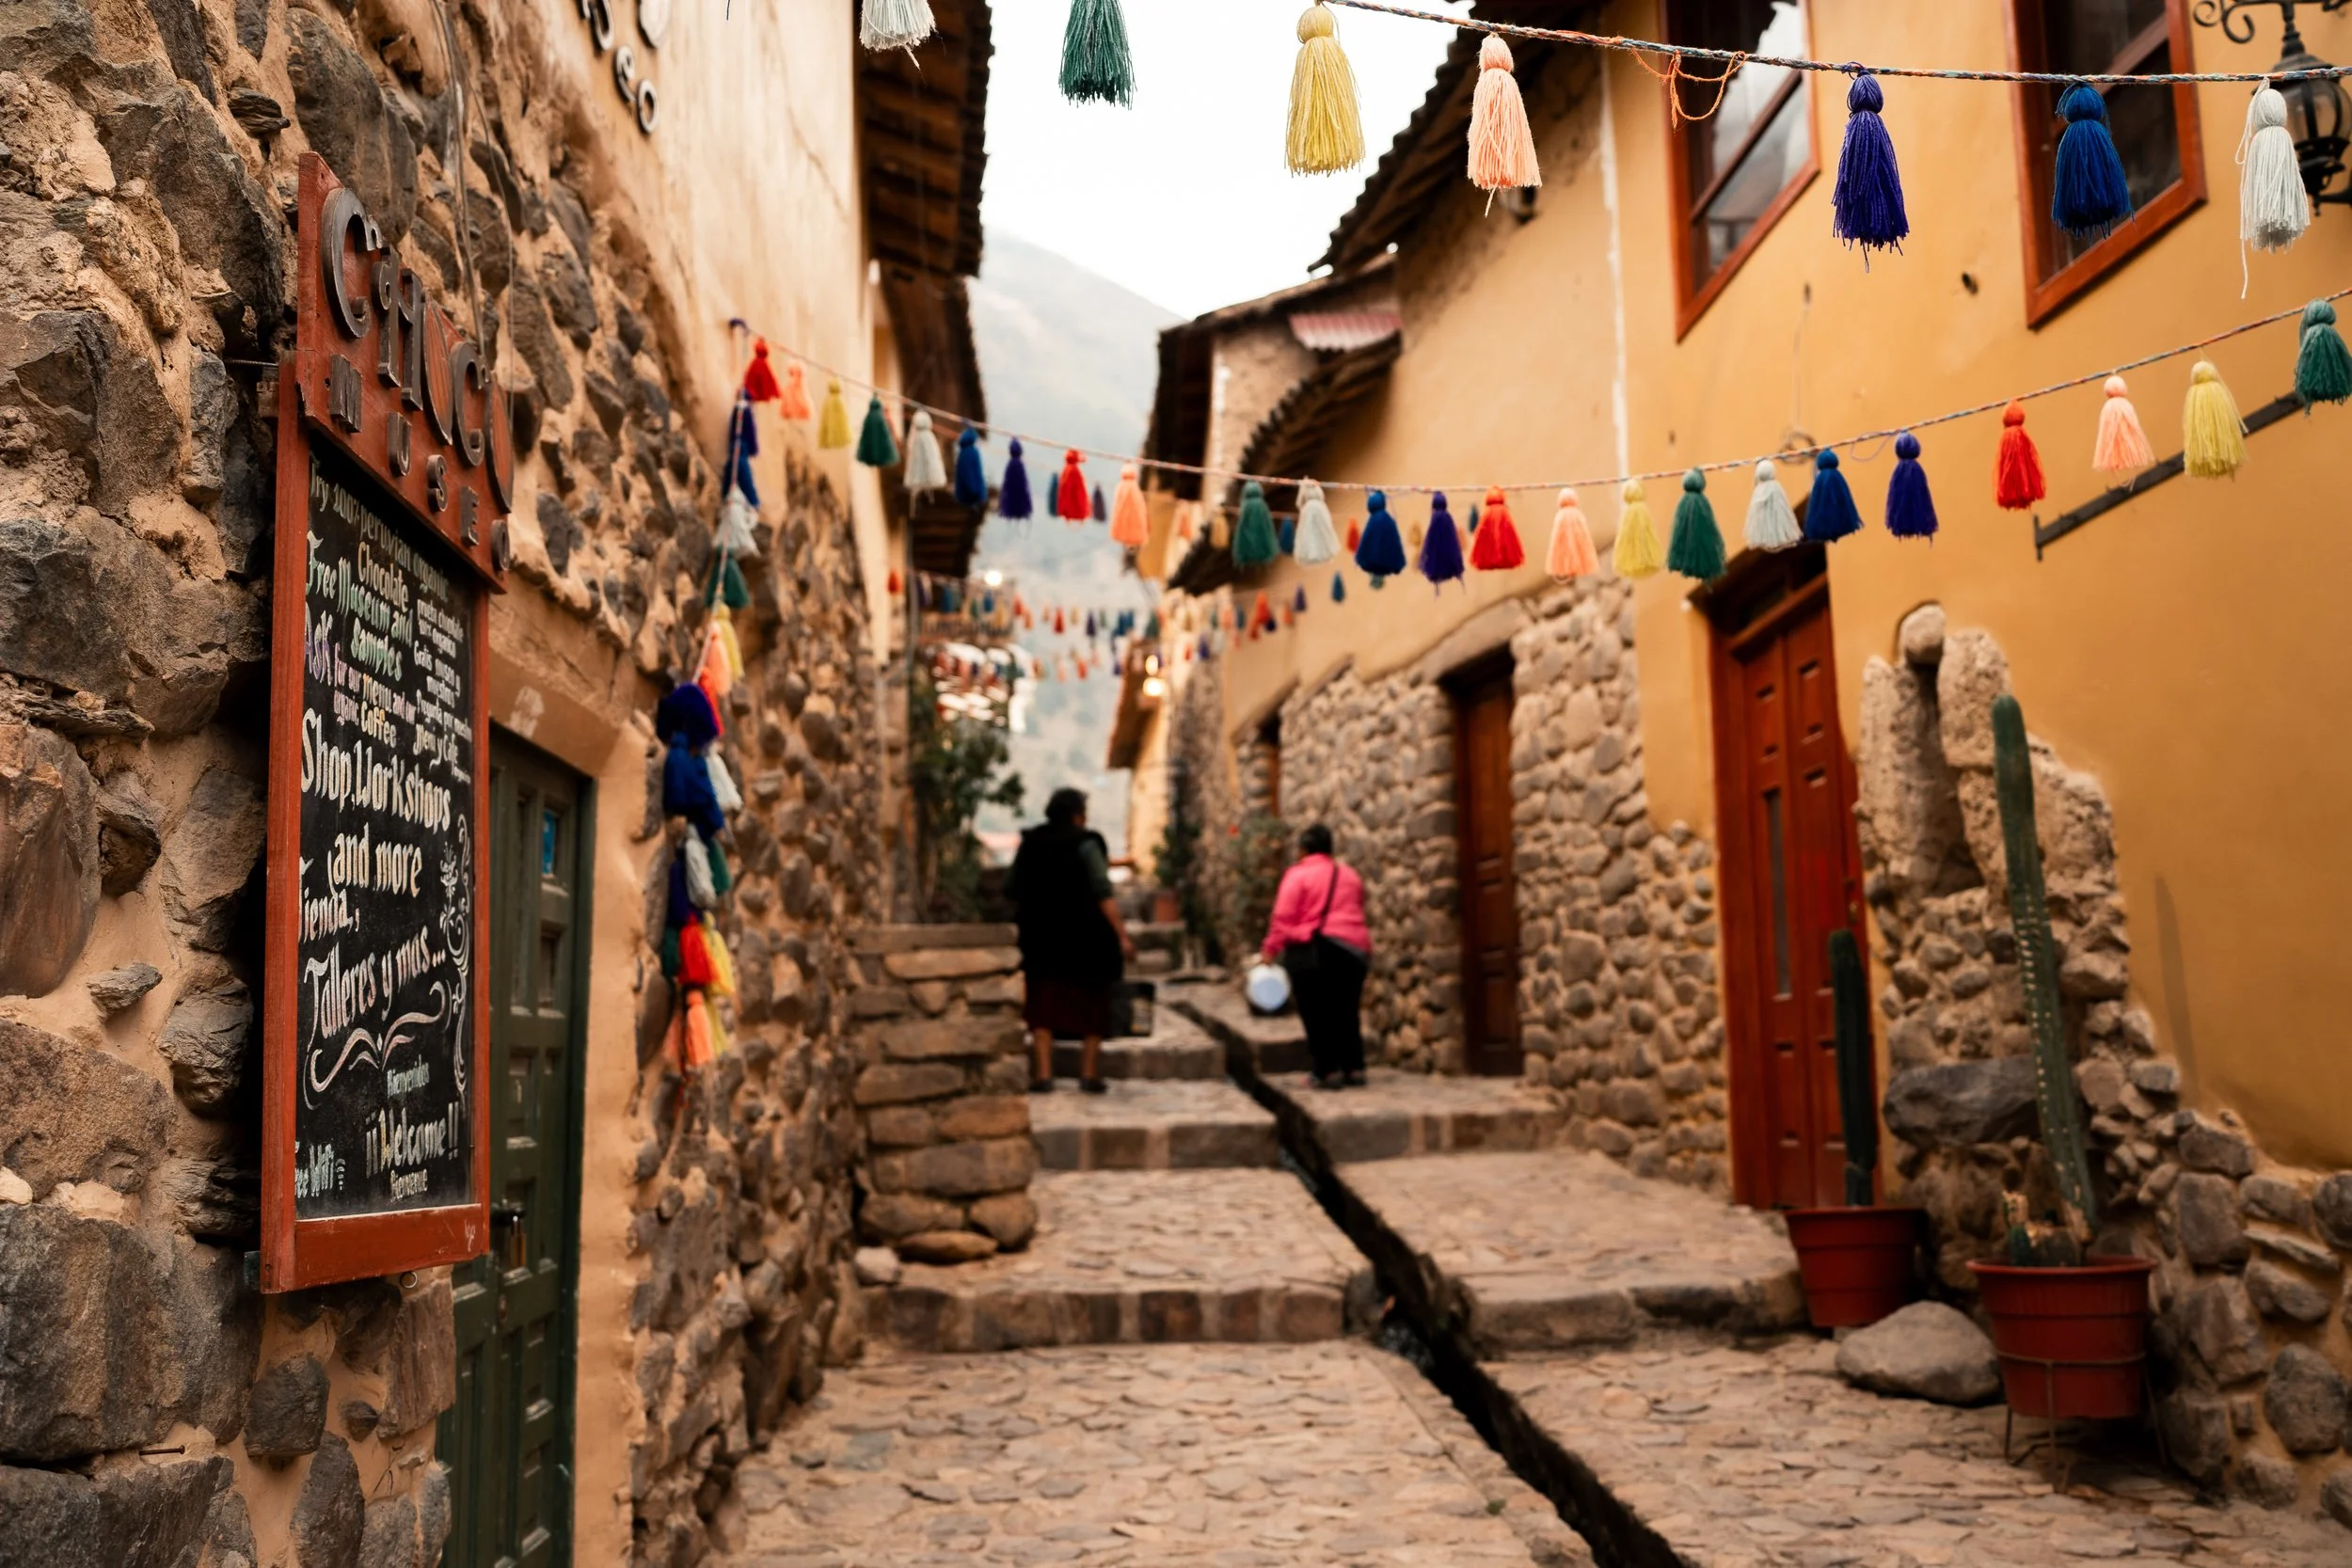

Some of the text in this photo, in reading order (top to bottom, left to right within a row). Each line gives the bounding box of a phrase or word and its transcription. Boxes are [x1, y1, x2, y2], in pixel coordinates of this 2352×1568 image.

[310, 451, 328, 512] Try
[333, 483, 360, 526] 100%
[360, 504, 411, 571] peruvian
[306, 531, 413, 648] Free Museum and
[358, 541, 409, 612] Chocolate
[351, 617, 402, 681] Samples
[361, 700, 397, 749] Coffee
[333, 822, 423, 898] and more
[304, 942, 376, 1050] Talleres
[381, 949, 392, 1022] y
